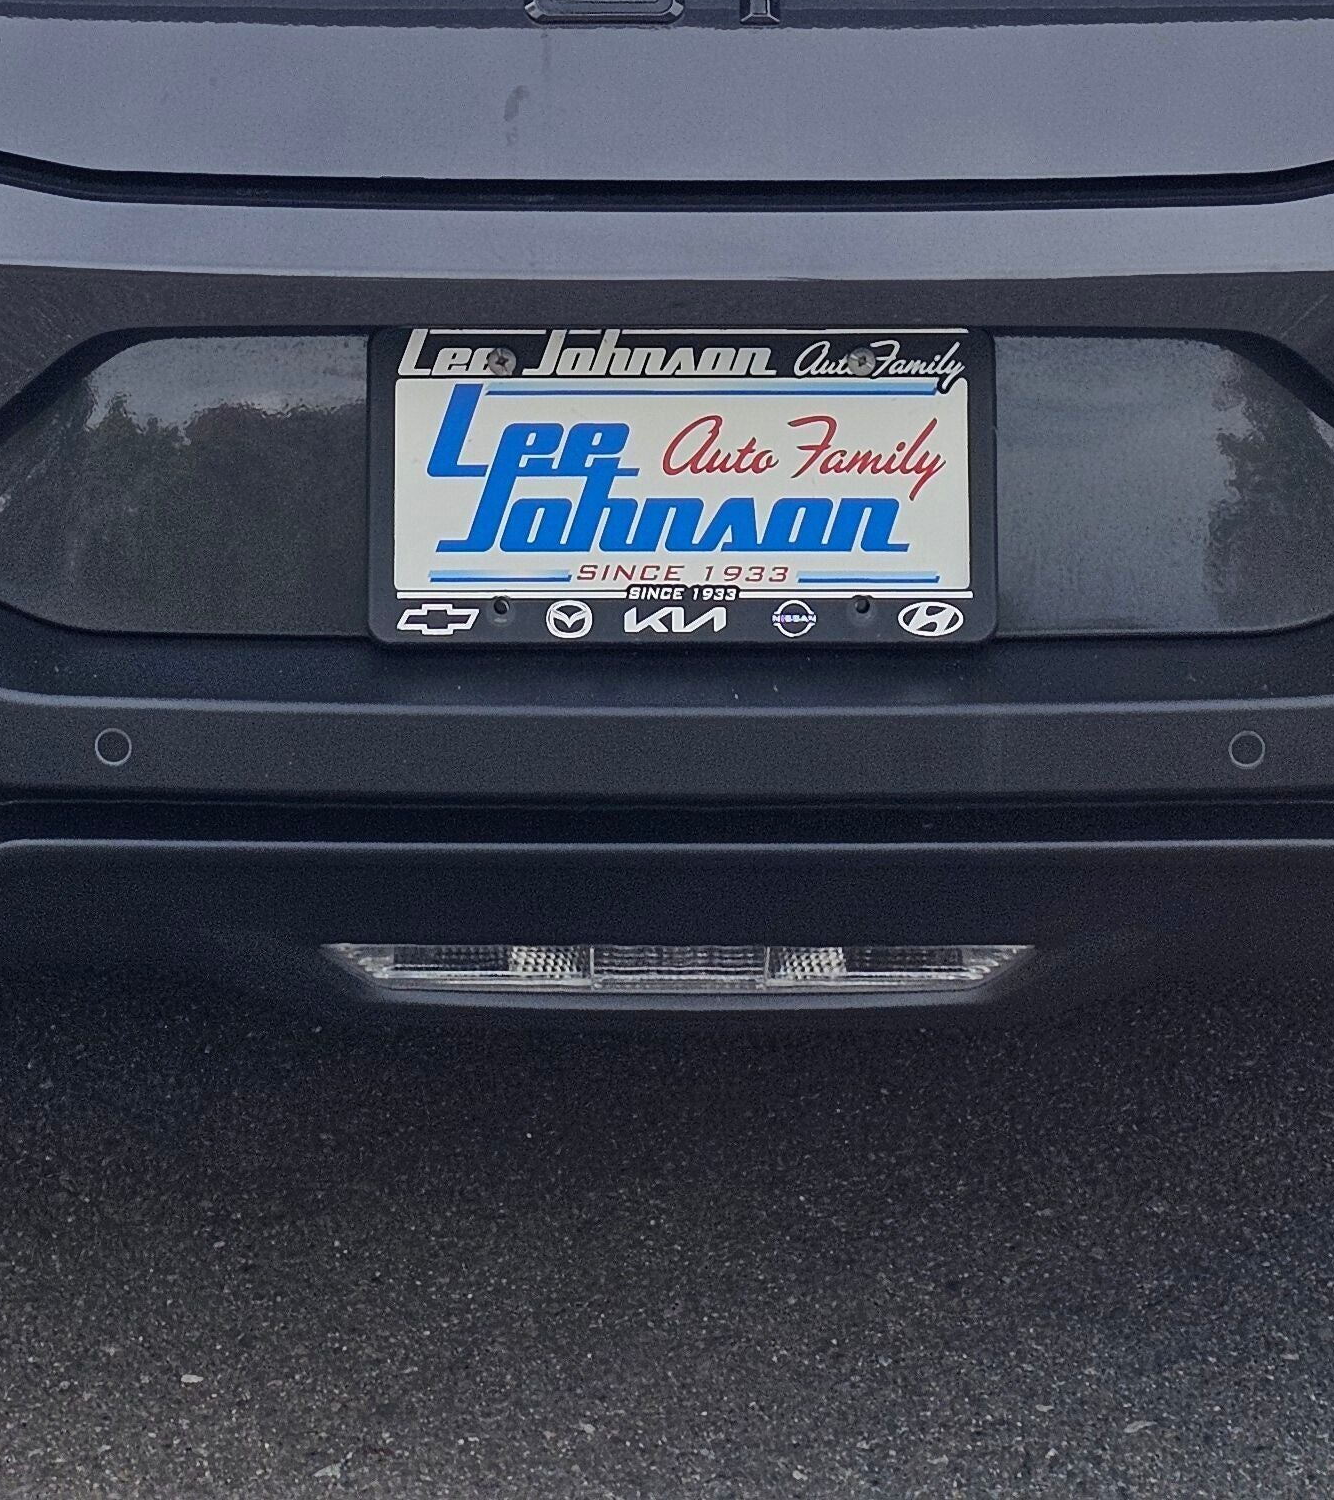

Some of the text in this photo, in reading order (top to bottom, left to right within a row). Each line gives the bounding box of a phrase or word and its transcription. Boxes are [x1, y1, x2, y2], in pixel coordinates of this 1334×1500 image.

[522, 328, 777, 376] Johnson
[793, 339, 966, 389] Aut Family
[427, 383, 640, 477] Lee
[662, 415, 946, 501] Auto Family
[436, 448, 910, 552] Johnson
[577, 564, 789, 582] SINCE 1933
[628, 586, 737, 601] SINCE 1933
[624, 606, 727, 633] KIA
[771, 614, 817, 623] NISSAN
